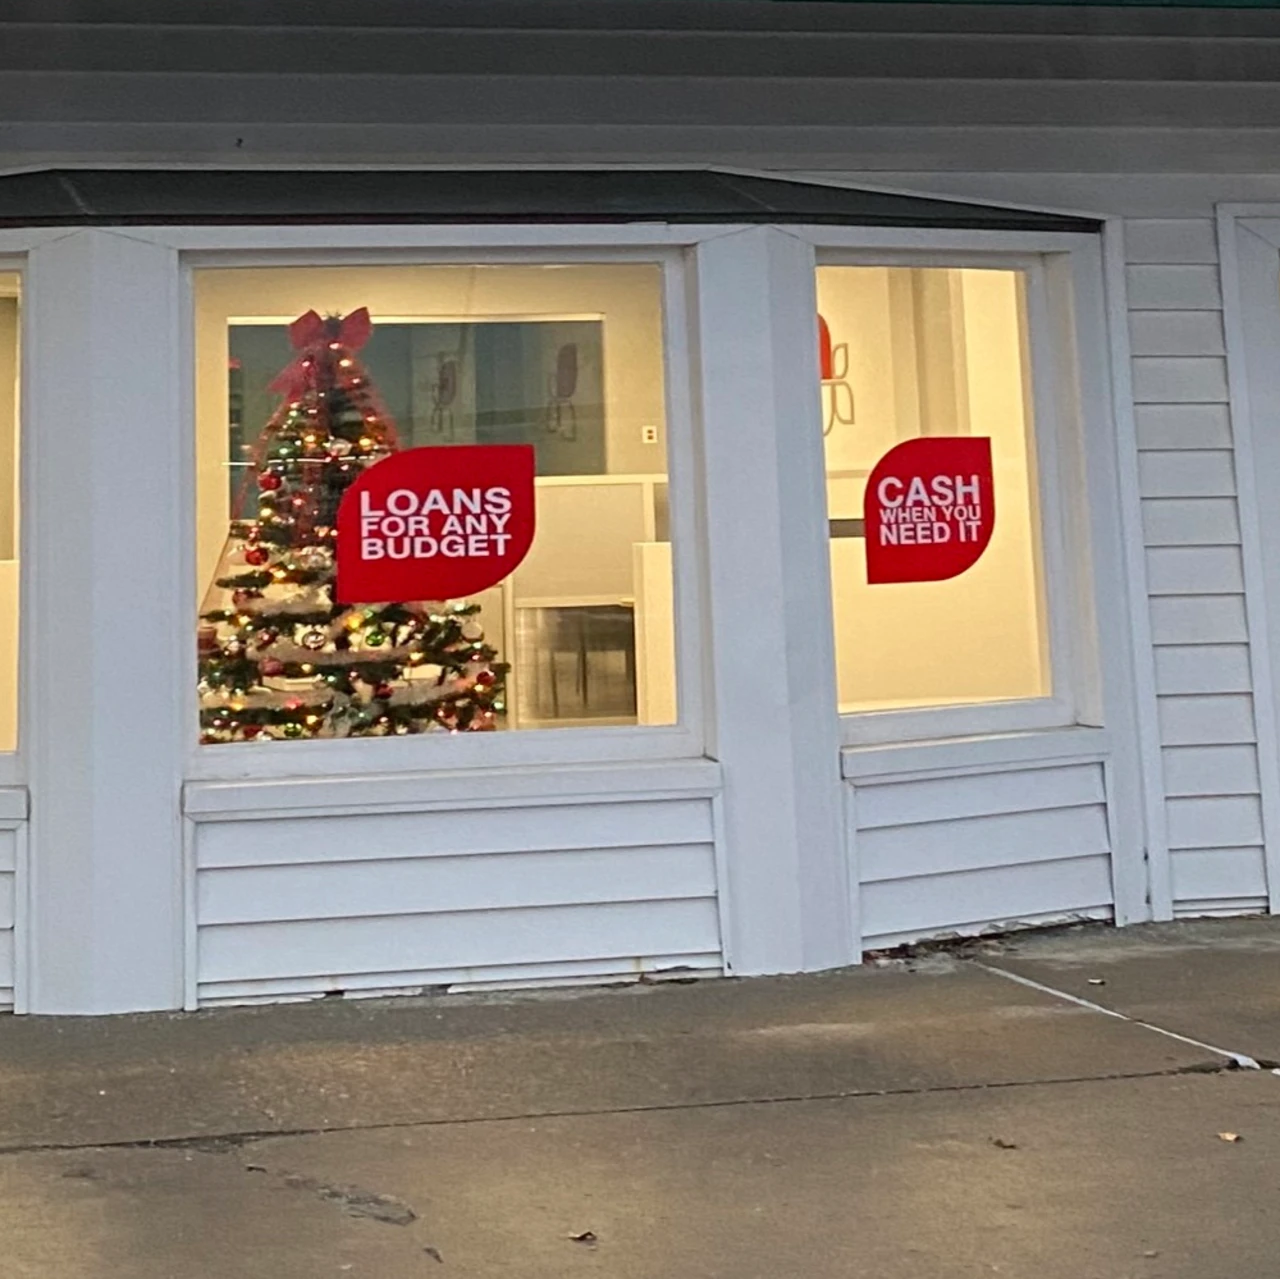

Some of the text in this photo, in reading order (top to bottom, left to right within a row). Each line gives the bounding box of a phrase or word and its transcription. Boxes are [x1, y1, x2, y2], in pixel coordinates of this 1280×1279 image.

[360, 487, 513, 517] LOANS
[877, 474, 980, 508] CASH
[361, 512, 511, 538] FOR ANY
[879, 504, 981, 524] WHEN YOU
[880, 520, 982, 546] NEED IT
[361, 533, 513, 561] BUDGET
